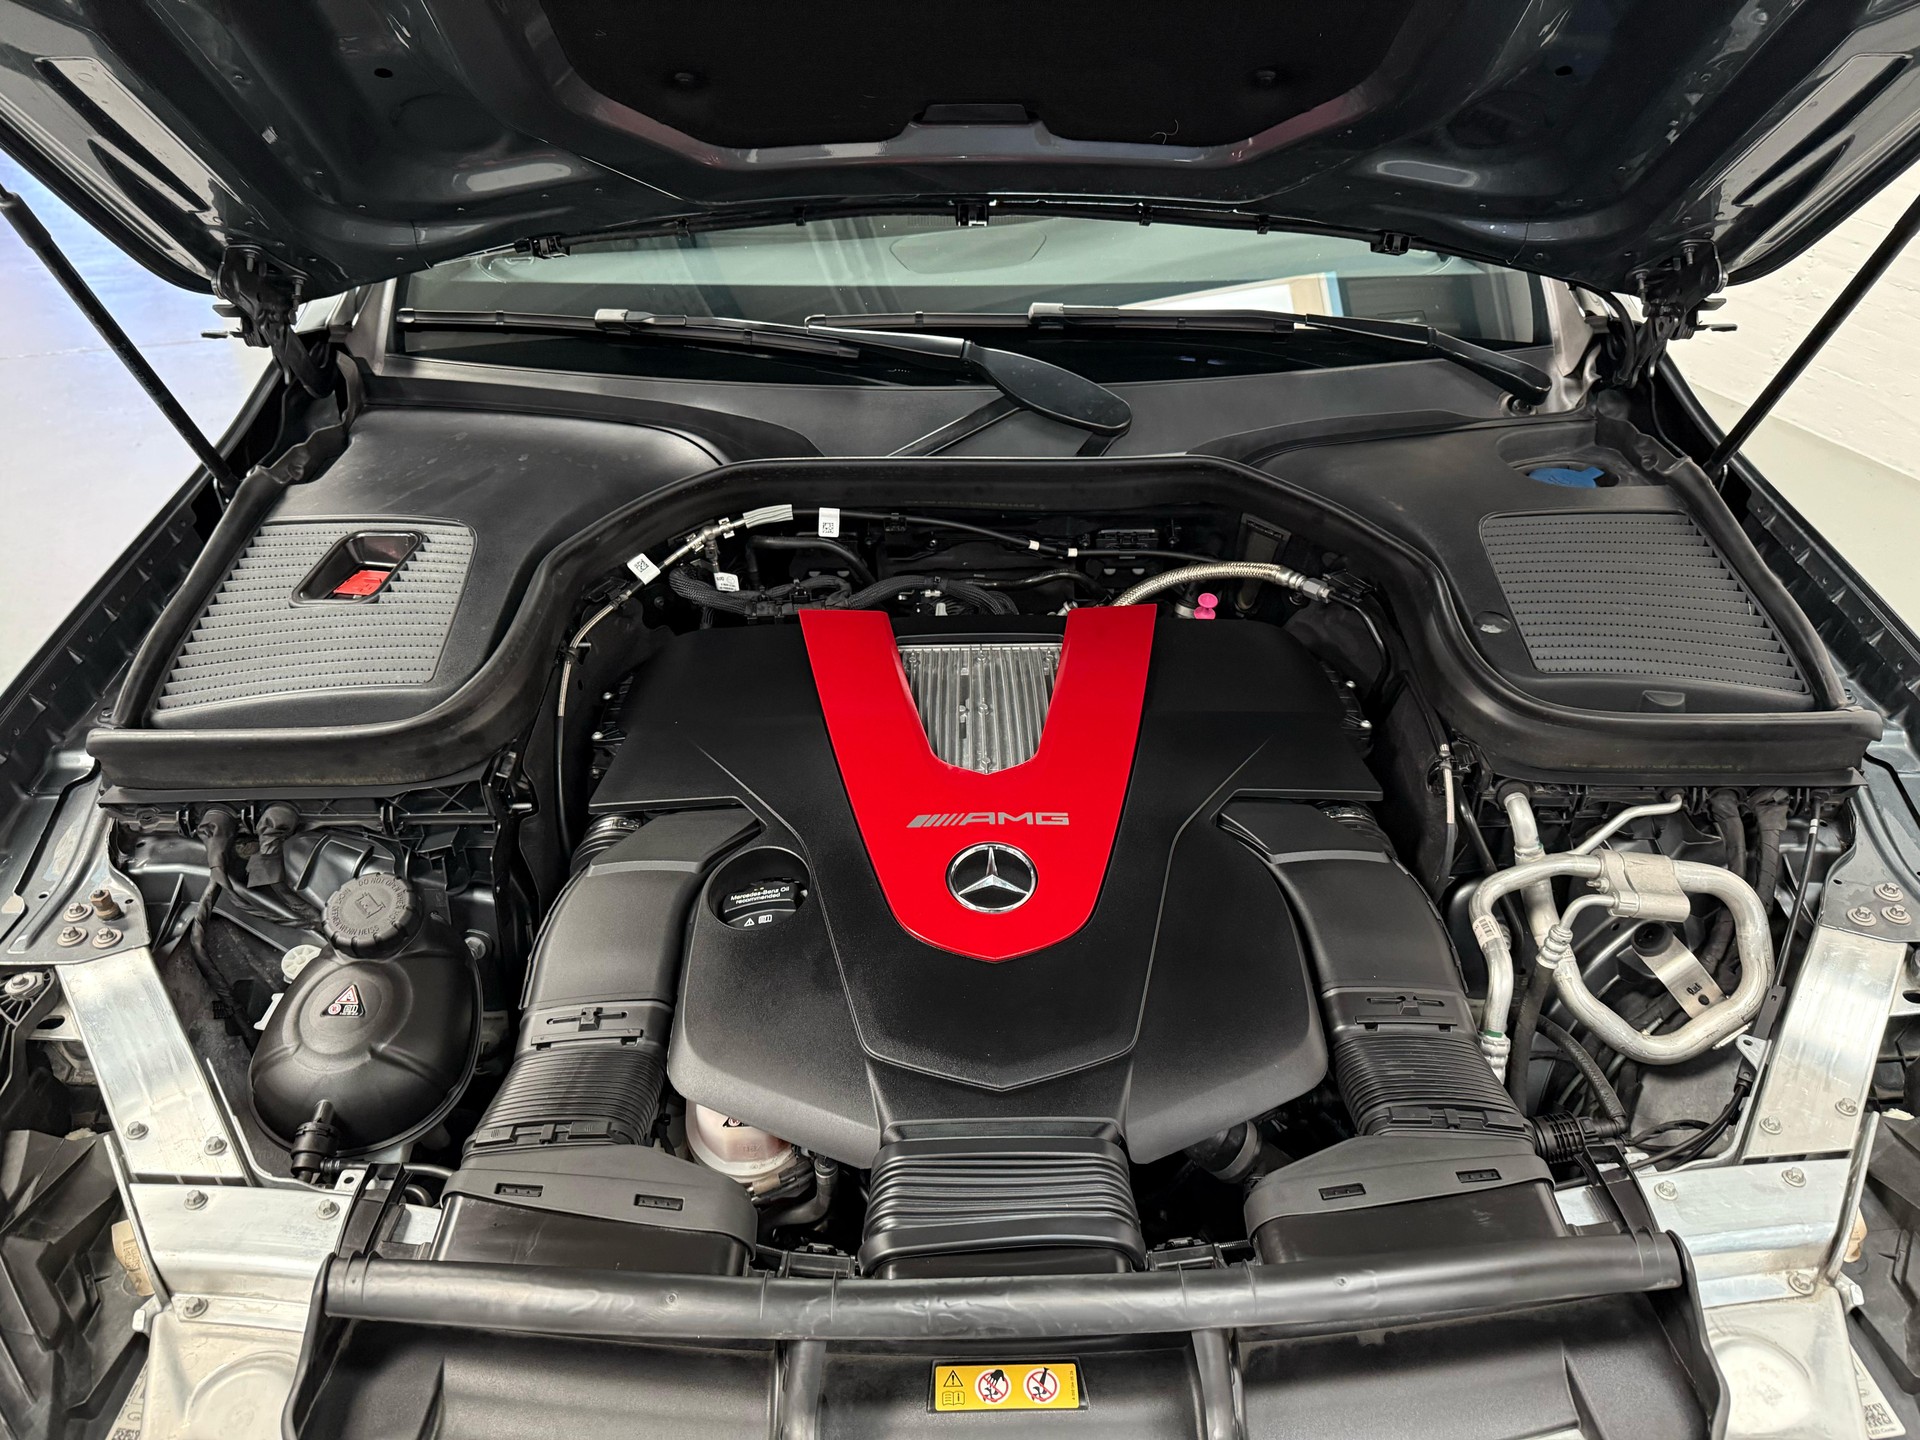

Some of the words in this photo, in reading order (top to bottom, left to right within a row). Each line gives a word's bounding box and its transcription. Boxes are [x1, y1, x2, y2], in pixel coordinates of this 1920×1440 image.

[958, 812, 1070, 826] AMG
[386, 879, 401, 892] OPEN
[730, 889, 779, 901] Mercedes-Benz
[735, 892, 781, 904] recommended
[358, 925, 379, 935] HEISS
